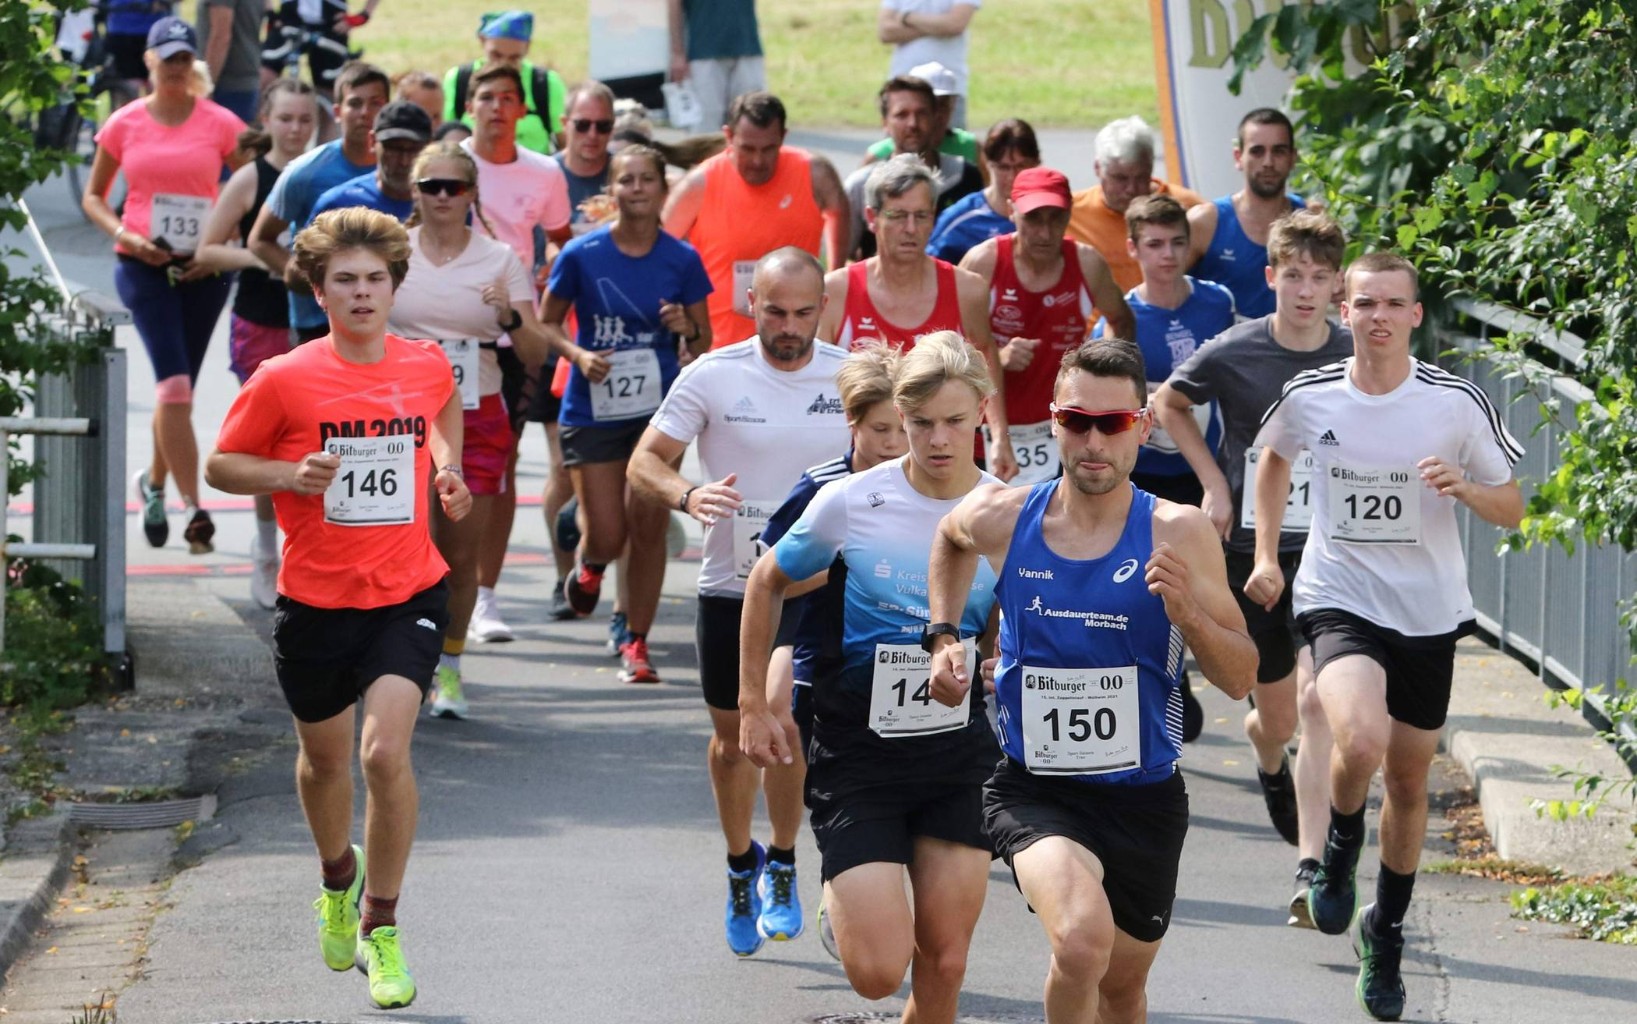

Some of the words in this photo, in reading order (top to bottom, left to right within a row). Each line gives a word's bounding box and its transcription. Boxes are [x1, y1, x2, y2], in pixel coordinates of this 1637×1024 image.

[162, 215, 199, 237] 133
[603, 375, 646, 398] 127
[340, 443, 377, 457] Bitburger
[341, 468, 397, 498] 146
[1341, 469, 1379, 483] Bitburger
[1345, 494, 1402, 520] 120
[1018, 567, 1054, 580] Yannik
[1044, 608, 1129, 623] Ausdauerteam.de
[1084, 619, 1127, 630] Morbach
[891, 651, 931, 665] Bitburge
[892, 678, 932, 707] 14
[1038, 675, 1086, 693] Bitburger
[1043, 707, 1117, 742] 150
